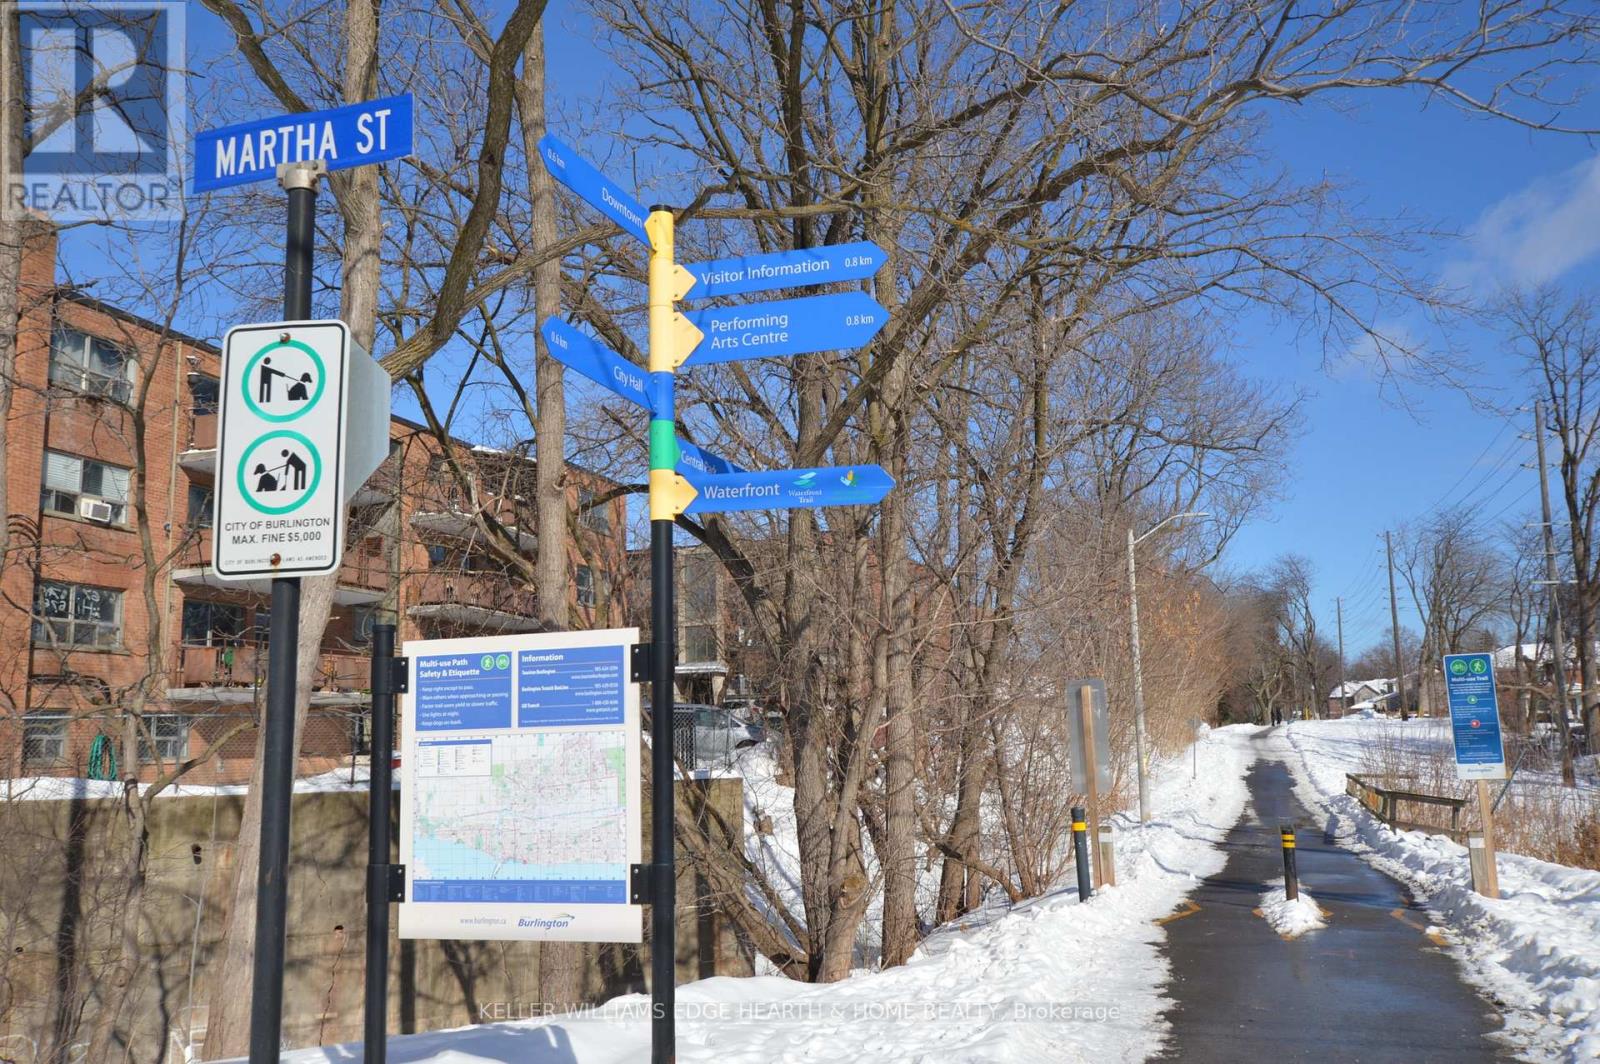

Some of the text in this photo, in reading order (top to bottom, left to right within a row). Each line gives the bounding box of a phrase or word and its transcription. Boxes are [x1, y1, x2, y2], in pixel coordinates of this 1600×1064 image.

[215, 109, 391, 178] MARTHA ST
[602, 187, 643, 228] Downtown
[844, 256, 873, 268] 0.8 km
[702, 259, 830, 286] Visitor Information
[711, 313, 788, 332] Performing
[846, 315, 874, 326] 0.8 km
[559, 338, 568, 349] km
[711, 331, 788, 349] Arts Centre
[613, 365, 643, 393] City Hall
[681, 449, 703, 472] Central
[704, 483, 780, 499] Waterfront
[788, 488, 822, 497] Waterfront
[225, 518, 330, 531] CITY OF BURLINGTON
[232, 531, 322, 544] MAX. FINE $5,000
[419, 658, 468, 668] Multi-use Path
[521, 653, 564, 662] Information
[419, 670, 441, 678] Safety
[448, 668, 480, 677] Etiquette
[517, 917, 569, 930] Burlington
